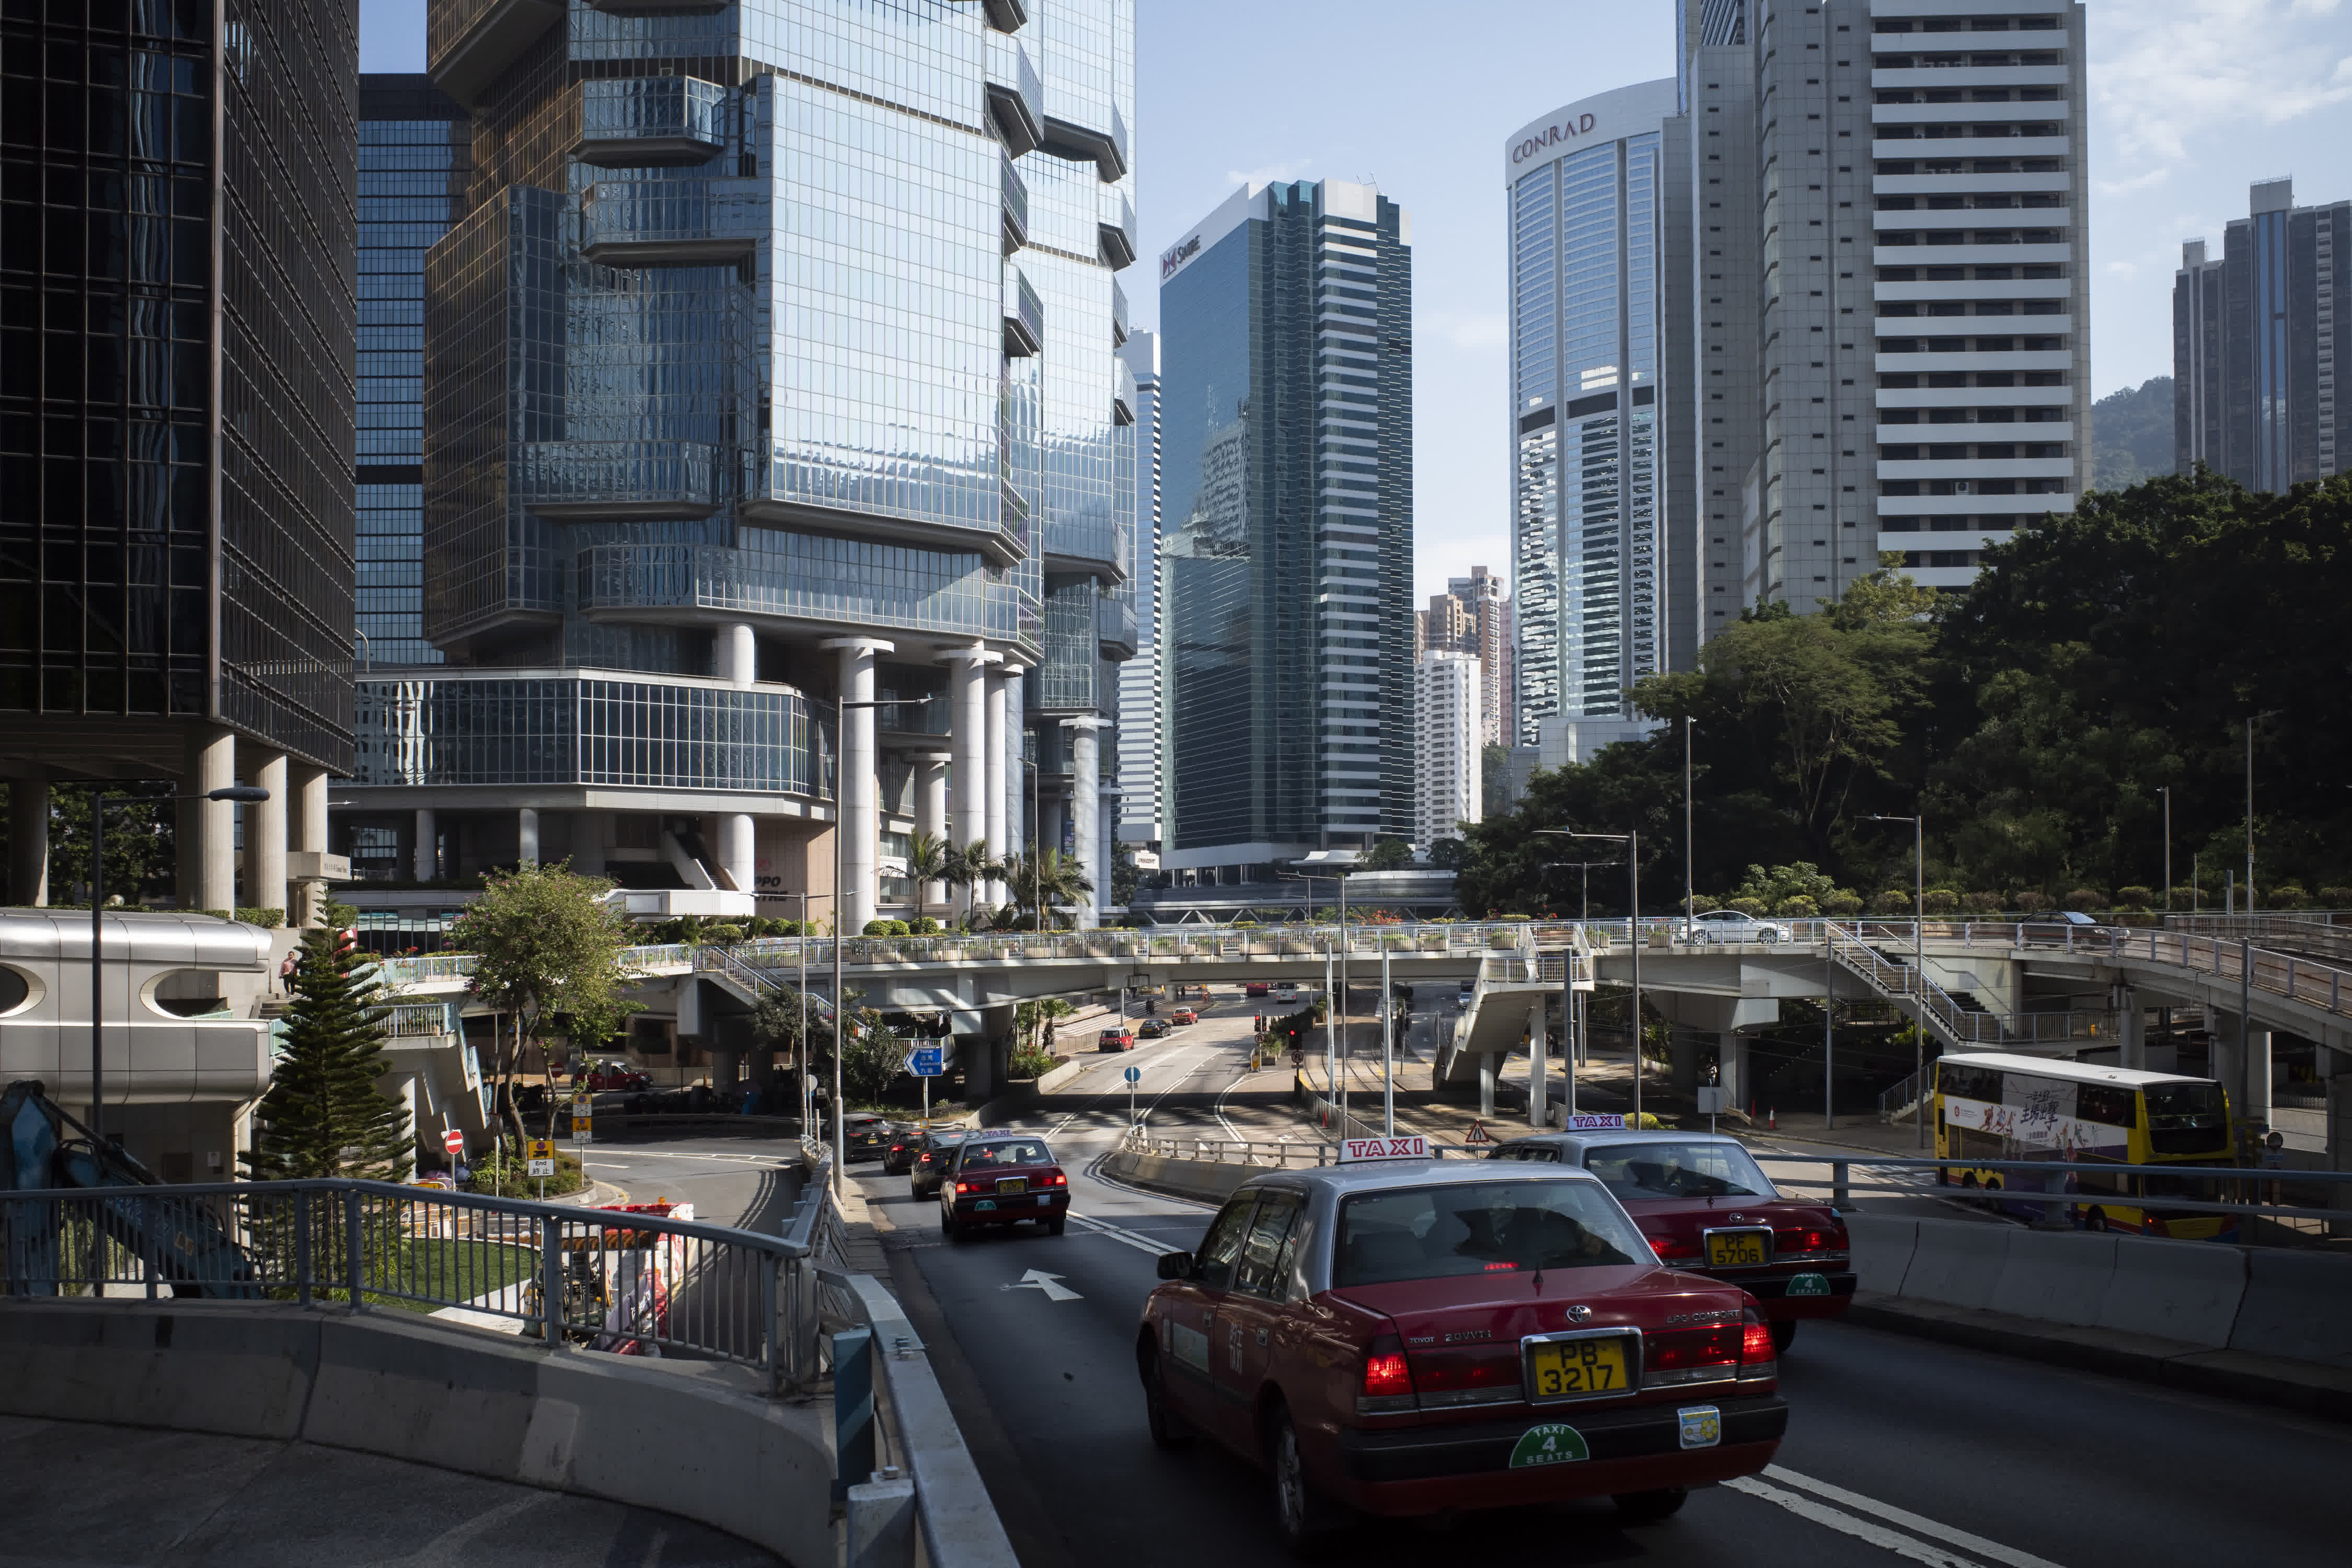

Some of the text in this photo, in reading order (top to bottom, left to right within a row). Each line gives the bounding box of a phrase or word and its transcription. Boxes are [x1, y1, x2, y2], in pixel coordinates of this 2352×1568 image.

[1512, 113, 1595, 164] CONRAD
[1573, 1116, 1621, 1127] TAXI
[1347, 1138, 1423, 1158] TAXI
[1726, 1234, 1745, 1250] PF
[1716, 1249, 1759, 1263] 5706
[1804, 1279, 1813, 1288] 4
[1560, 1342, 1598, 1368] PB
[1543, 1365, 1613, 1393] 3217
[1533, 1425, 1565, 1437] TAXI
[1542, 1436, 1557, 1451] 4
[1526, 1451, 1573, 1464] SEATS
